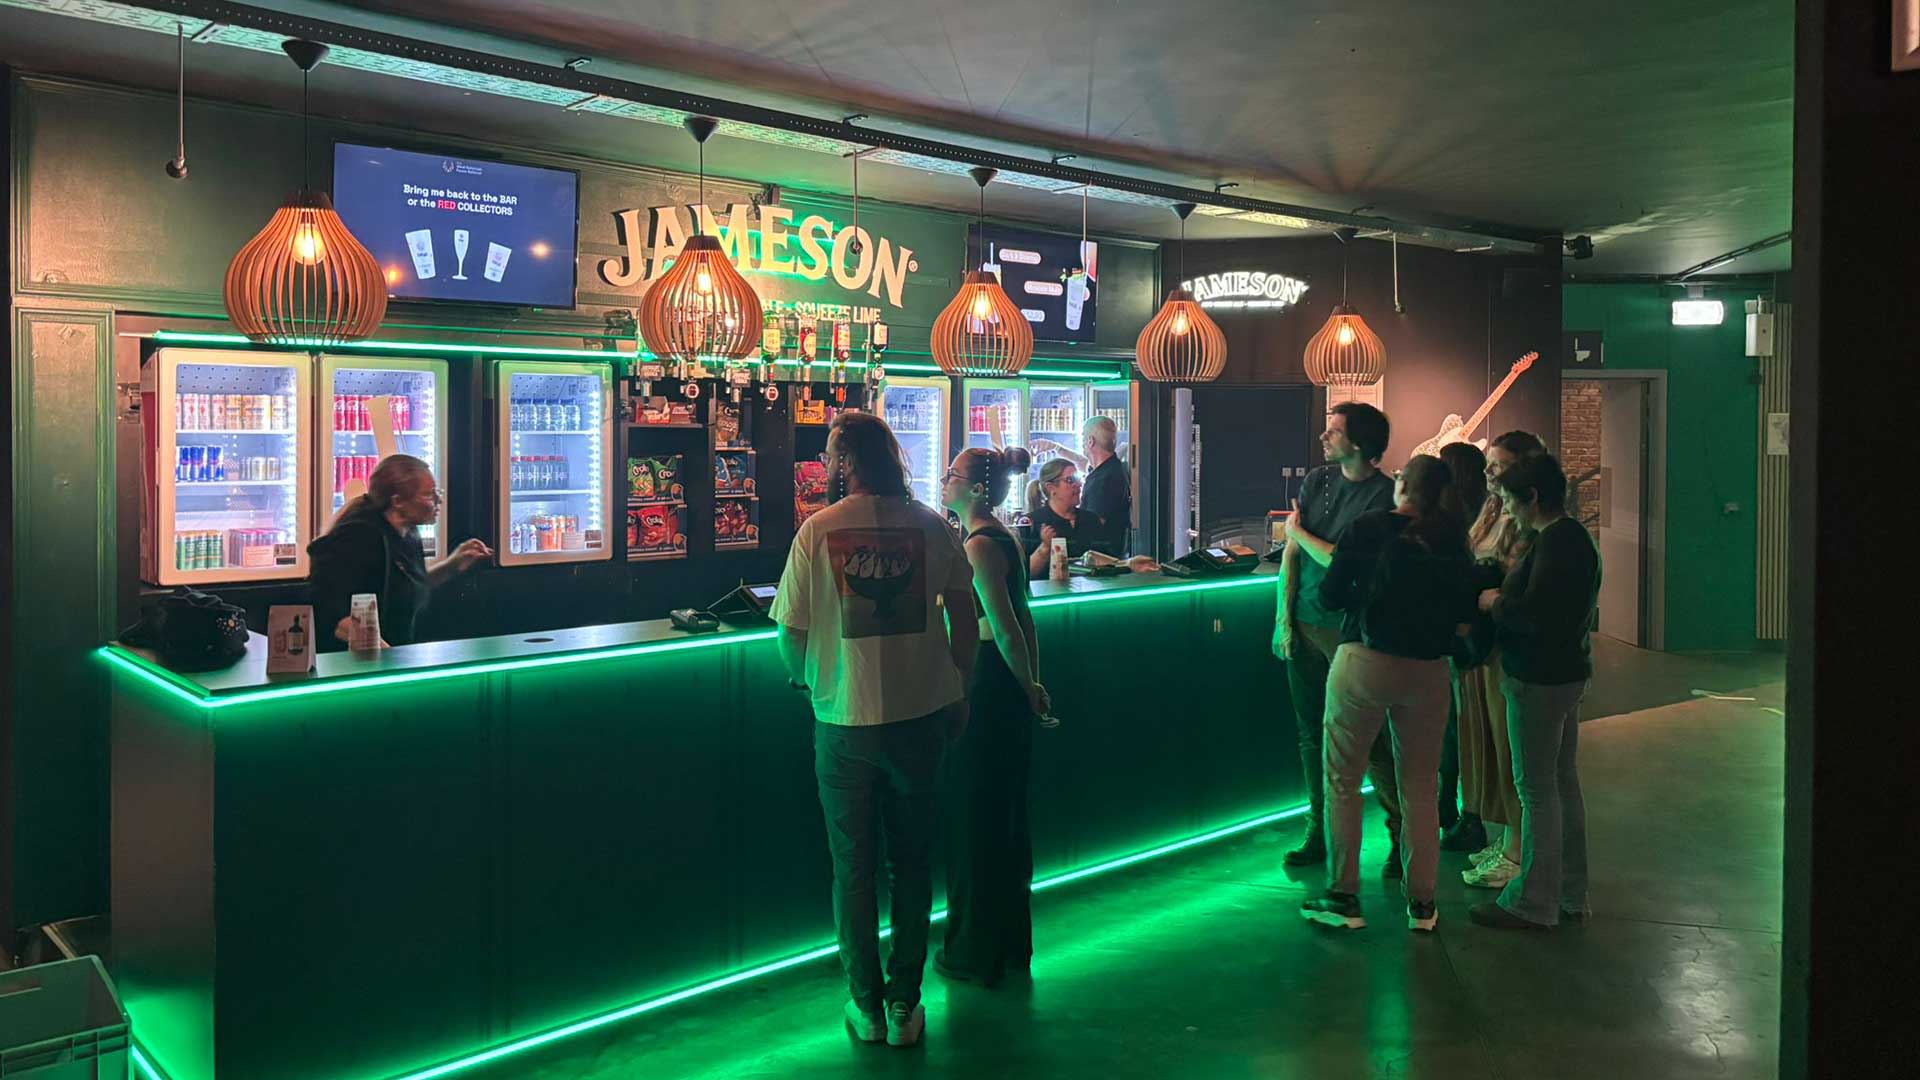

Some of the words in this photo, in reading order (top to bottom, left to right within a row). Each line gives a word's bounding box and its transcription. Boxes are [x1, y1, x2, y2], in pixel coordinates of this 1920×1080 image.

[403, 184, 429, 197] Bring
[431, 189, 445, 197] me
[446, 189, 469, 200] back
[471, 192, 481, 201] to
[482, 193, 498, 203] the
[499, 195, 518, 205] BAR
[407, 198, 418, 206] or
[420, 199, 436, 208] the
[438, 200, 456, 210] RED
[457, 202, 513, 216] COLLECTORS
[602, 203, 912, 308] JAMESON
[853, 306, 881, 324] LIME
